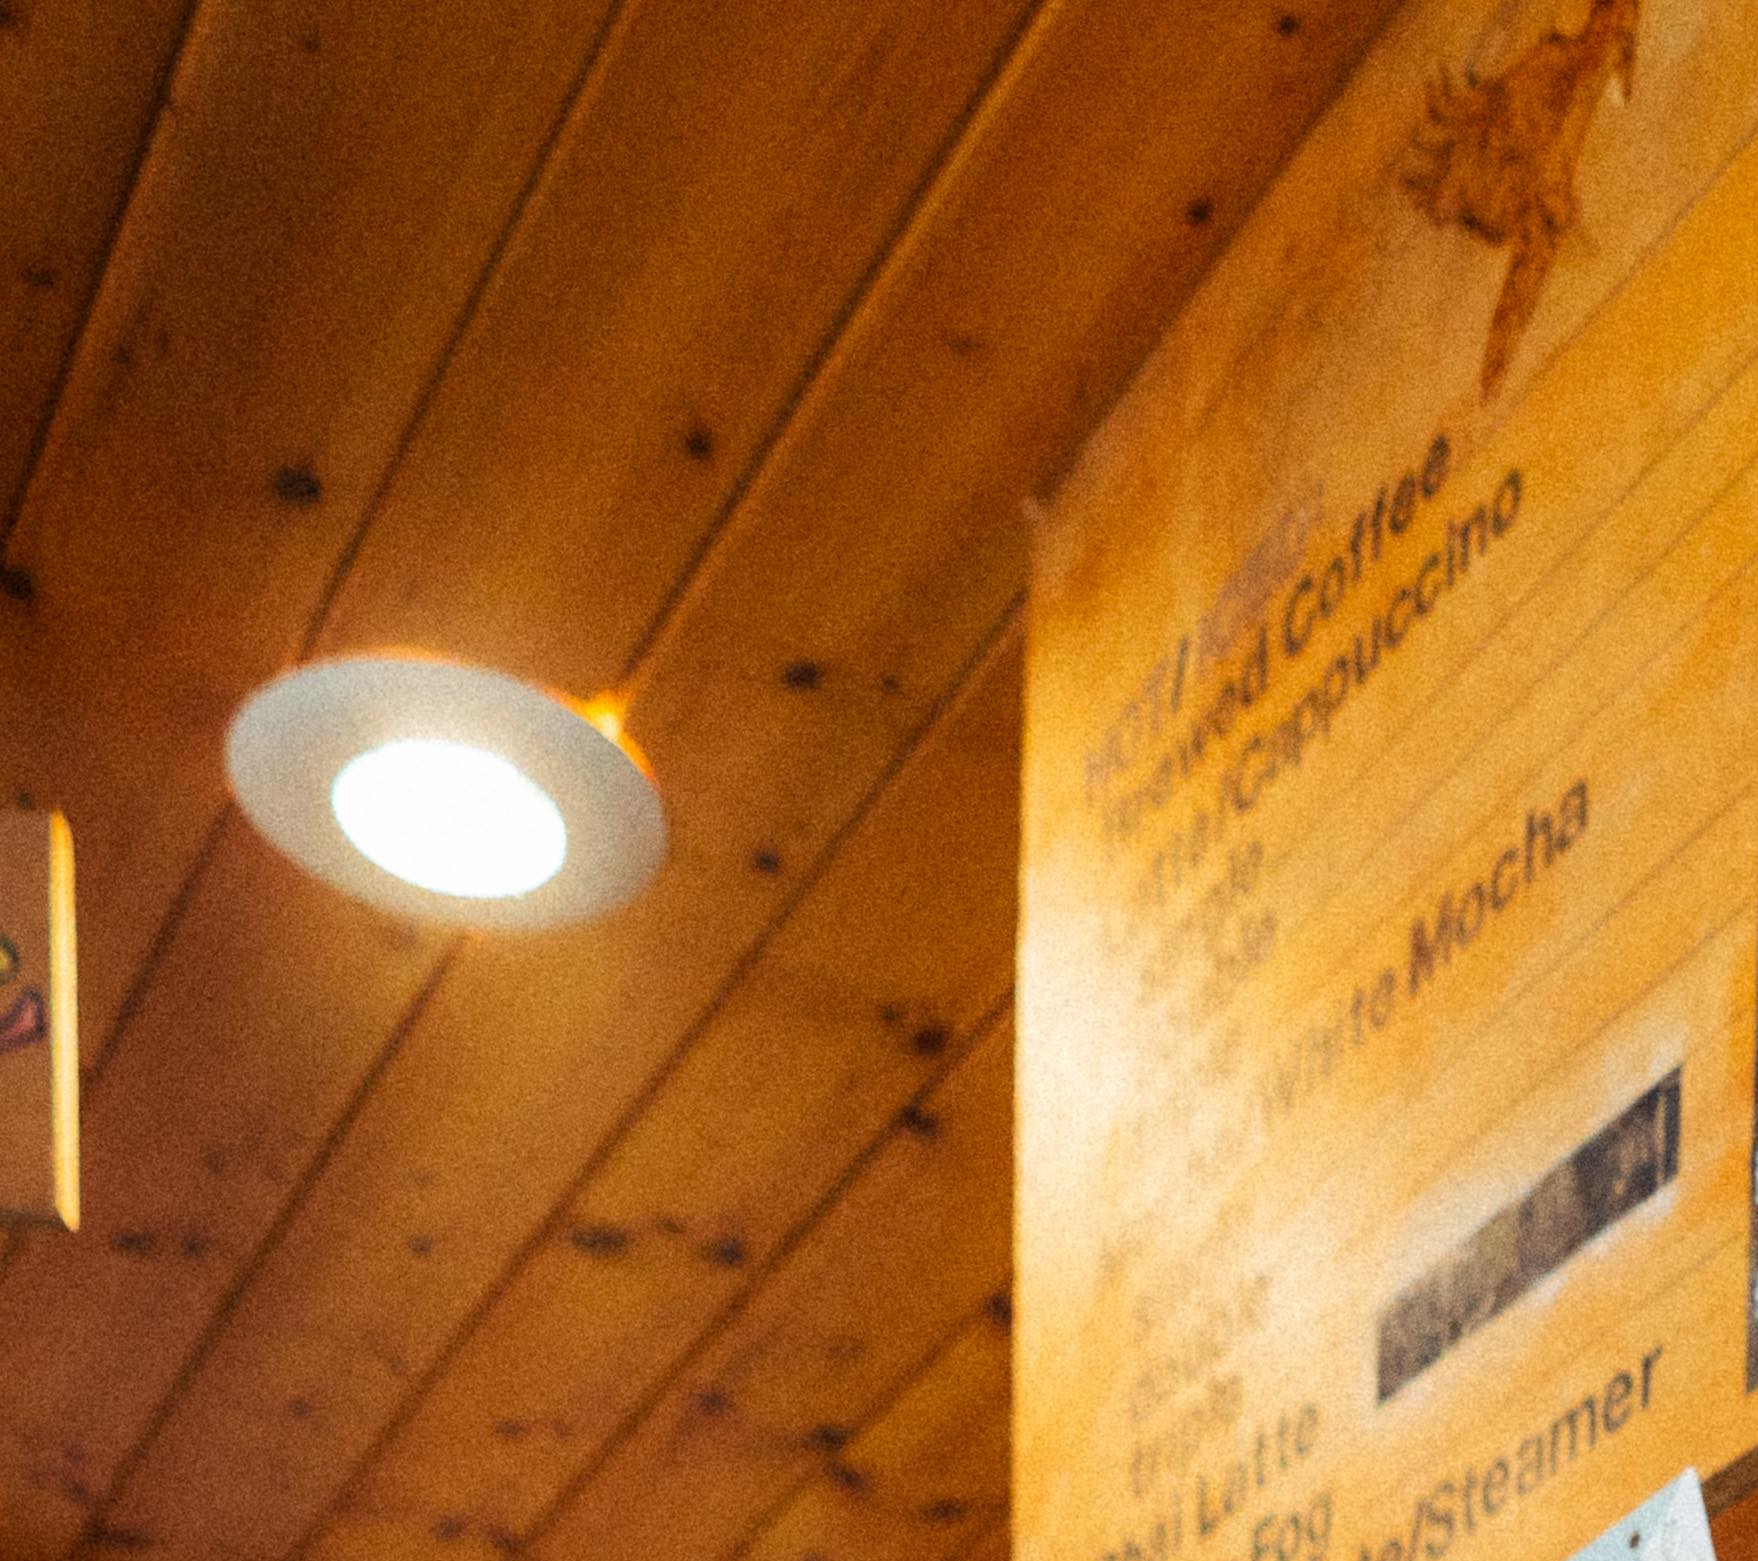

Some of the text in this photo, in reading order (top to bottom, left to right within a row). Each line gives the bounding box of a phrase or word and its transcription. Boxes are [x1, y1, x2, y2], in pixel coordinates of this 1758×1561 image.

[1285, 434, 1451, 656] Coffee
[1408, 777, 1591, 998] Mocha
[1199, 1402, 1322, 1541] Latte
